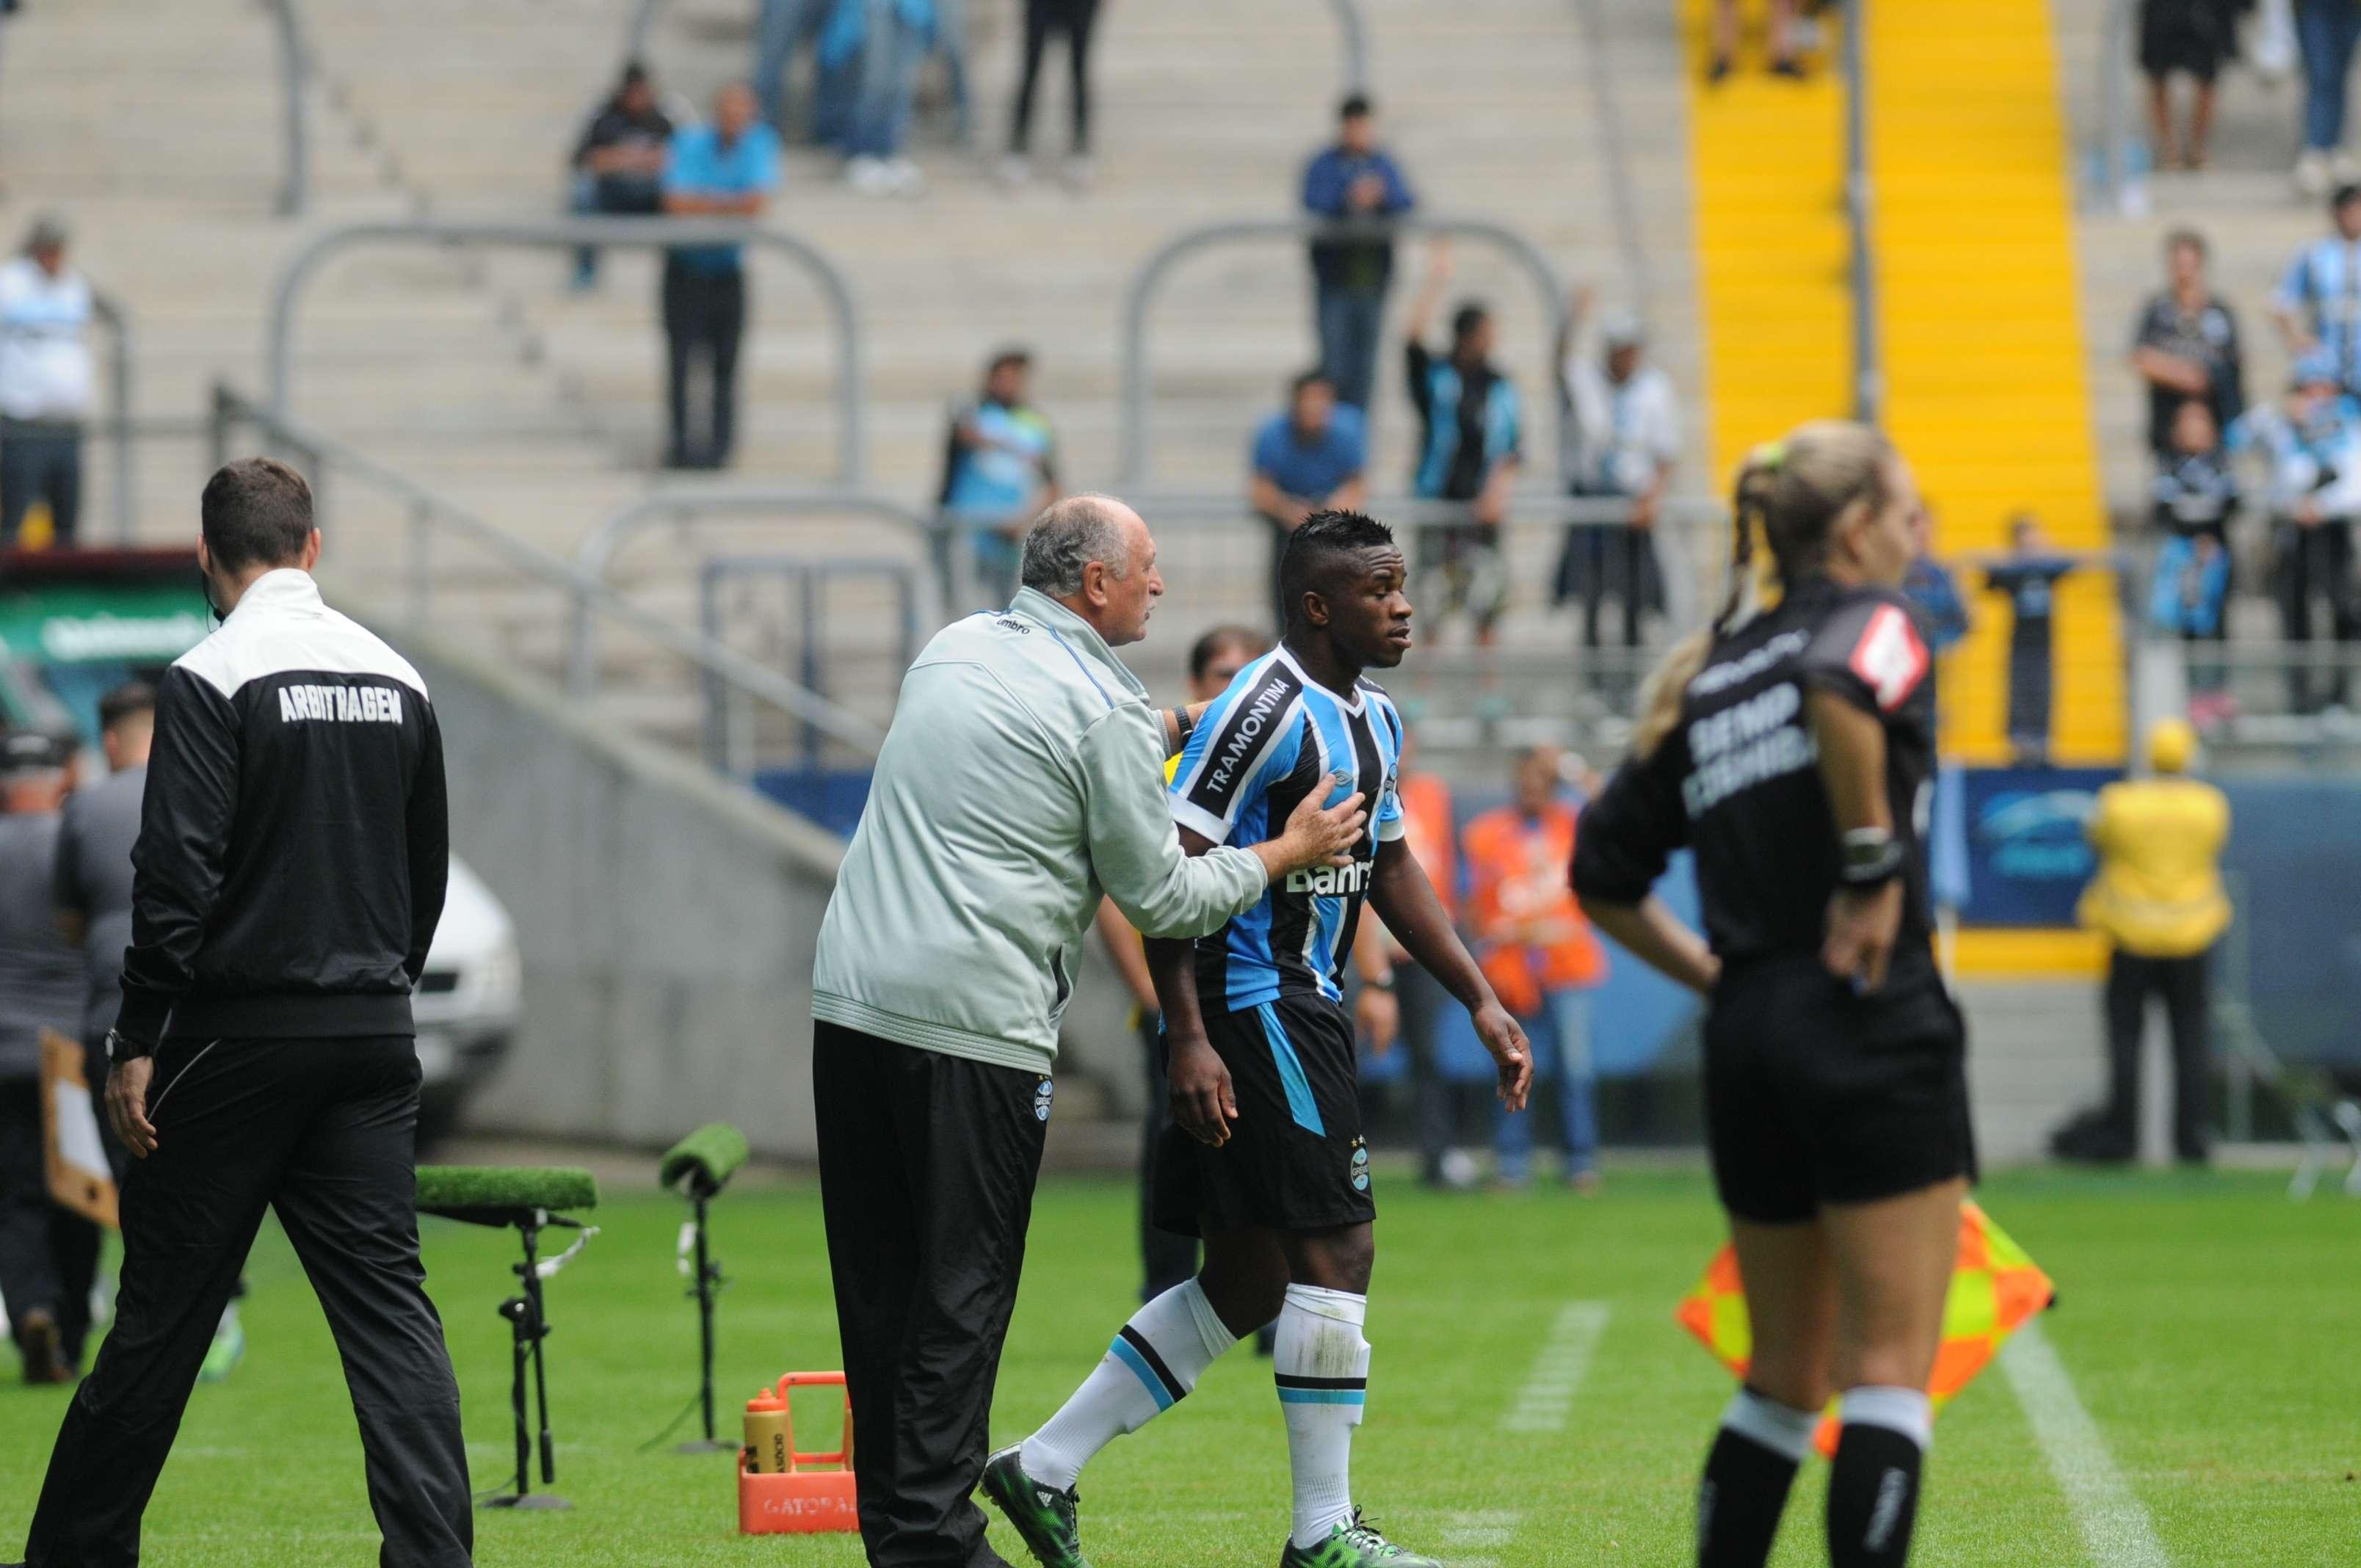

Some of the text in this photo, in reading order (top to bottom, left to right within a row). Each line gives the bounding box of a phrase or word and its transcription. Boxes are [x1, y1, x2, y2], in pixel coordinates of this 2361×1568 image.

[996, 618, 1031, 635] umbro
[1206, 678, 1291, 795] TRAMONTINA
[764, 1497, 856, 1516] GATORA
